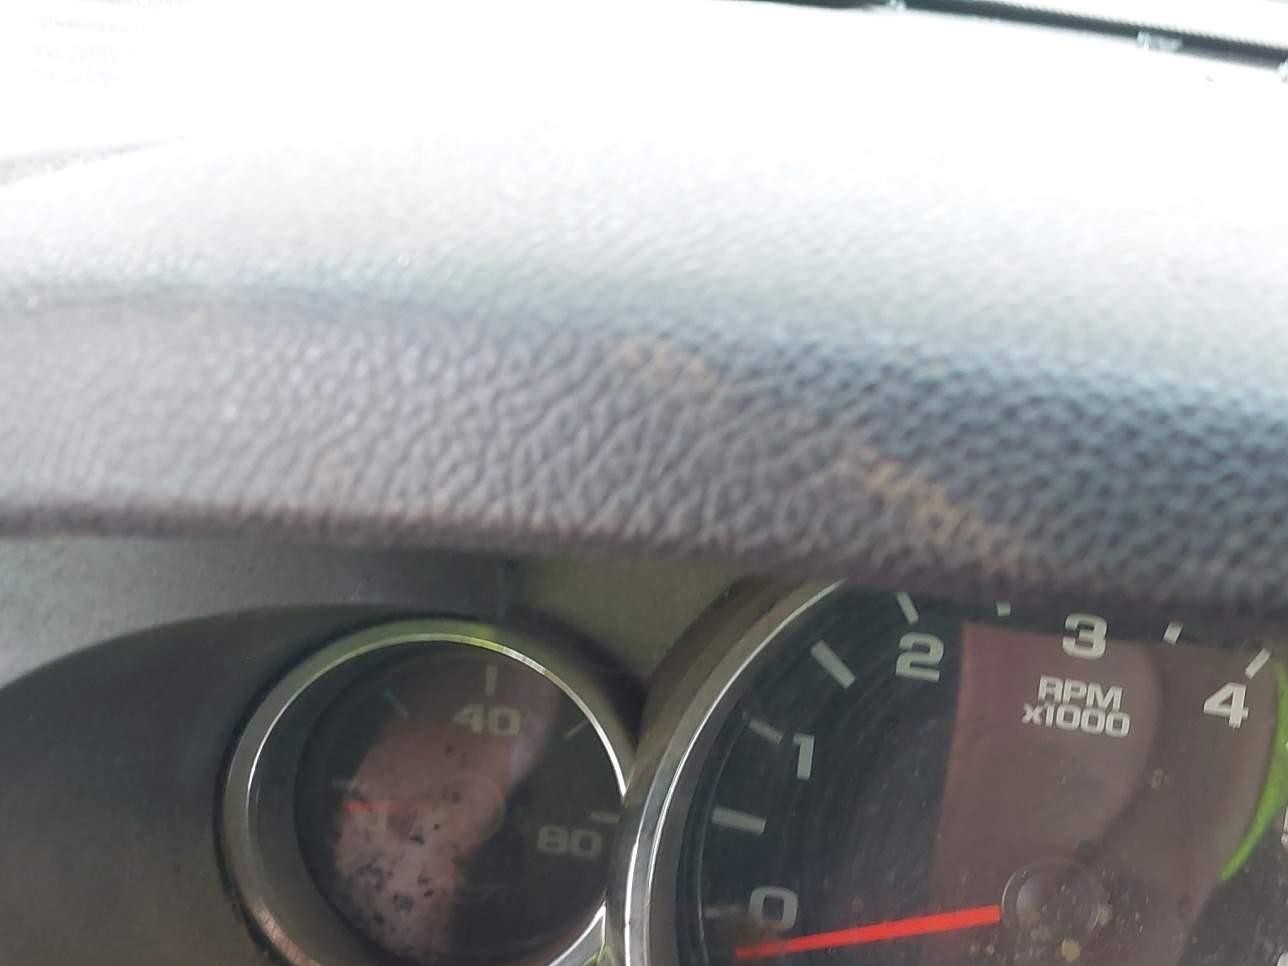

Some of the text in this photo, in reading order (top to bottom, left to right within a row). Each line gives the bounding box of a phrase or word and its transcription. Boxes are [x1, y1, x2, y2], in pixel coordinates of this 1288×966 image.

[895, 632, 945, 682] 2
[1062, 613, 1108, 660] 3
[1038, 676, 1122, 710] RPM
[1204, 682, 1249, 729] 4
[454, 704, 521, 737] 40
[1021, 702, 1131, 738] x1000
[792, 734, 815, 780] 1
[537, 825, 602, 858] 80
[747, 885, 798, 934] 0
